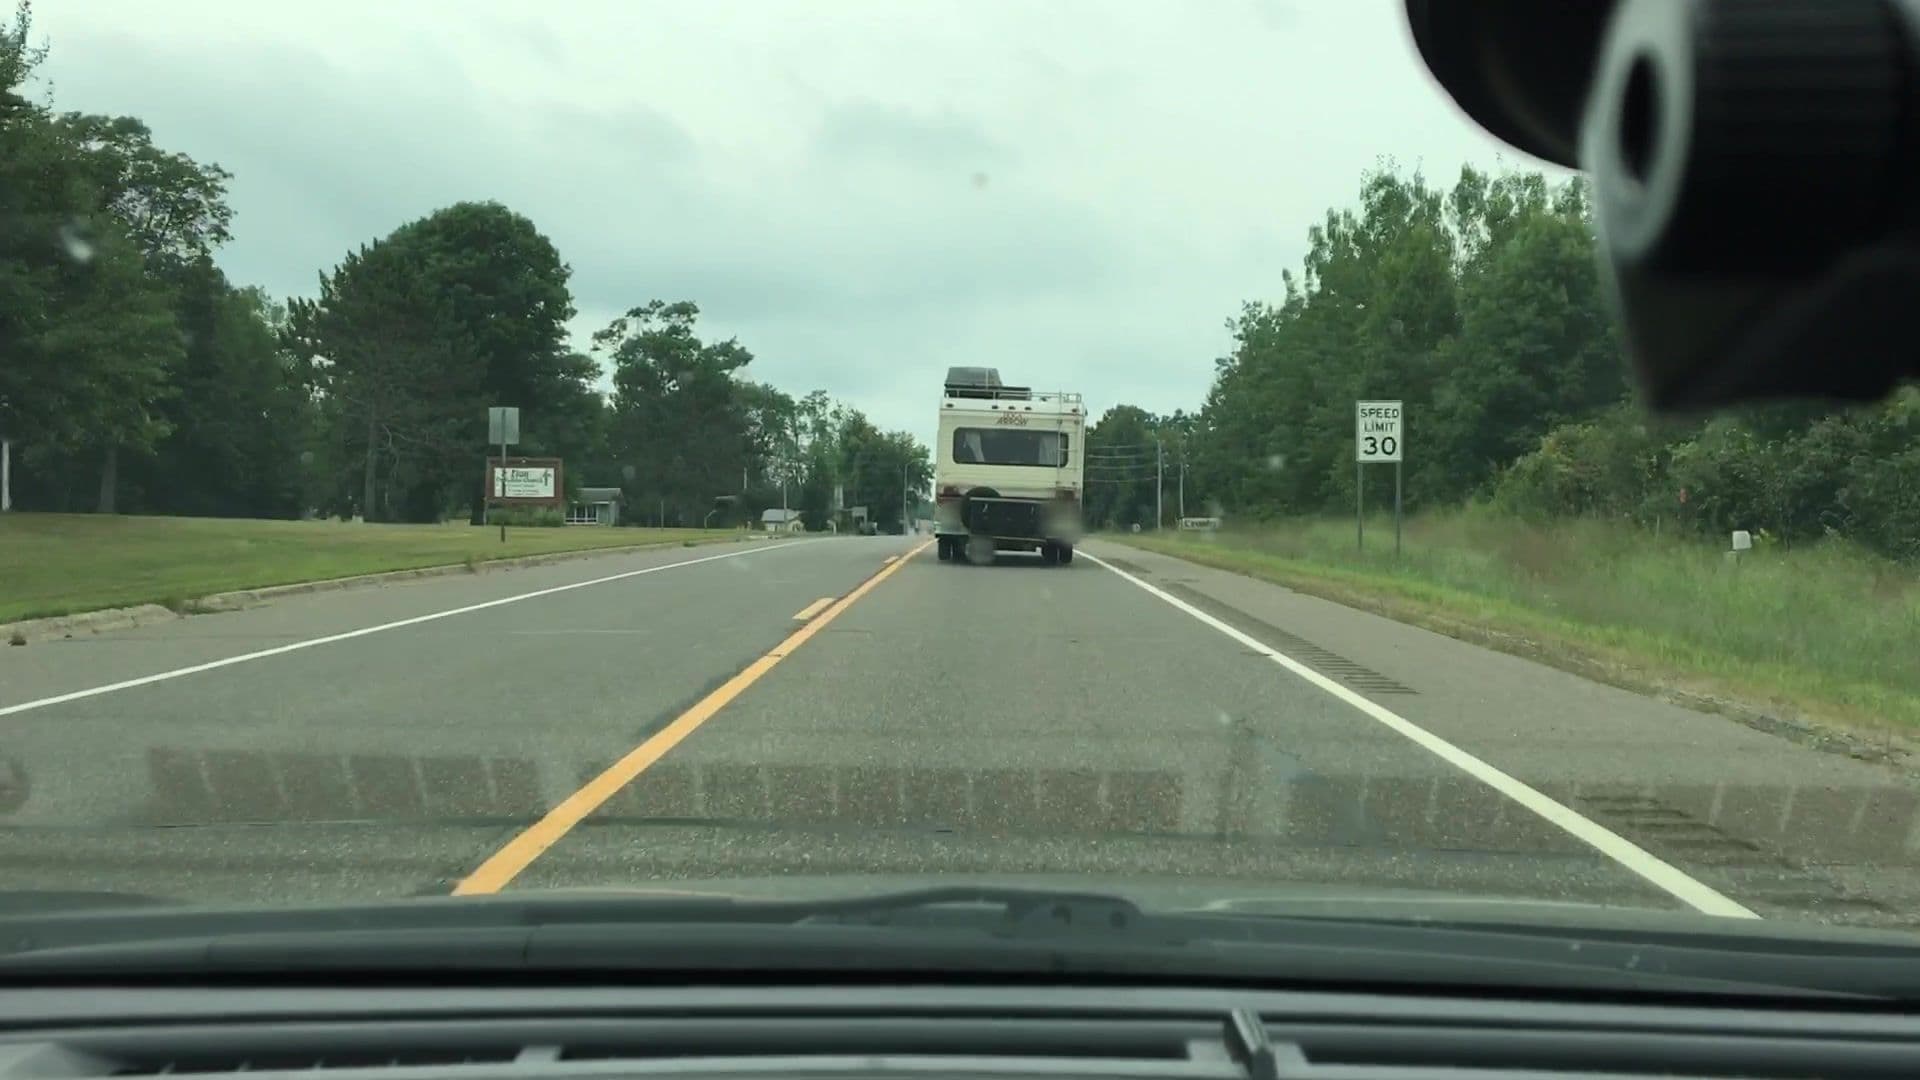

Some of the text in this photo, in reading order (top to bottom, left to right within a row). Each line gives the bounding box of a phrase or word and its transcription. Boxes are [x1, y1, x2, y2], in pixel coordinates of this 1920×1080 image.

[1360, 408, 1399, 418] SPEED
[1364, 422, 1395, 432] LIMIT
[1363, 436, 1397, 456] 30
